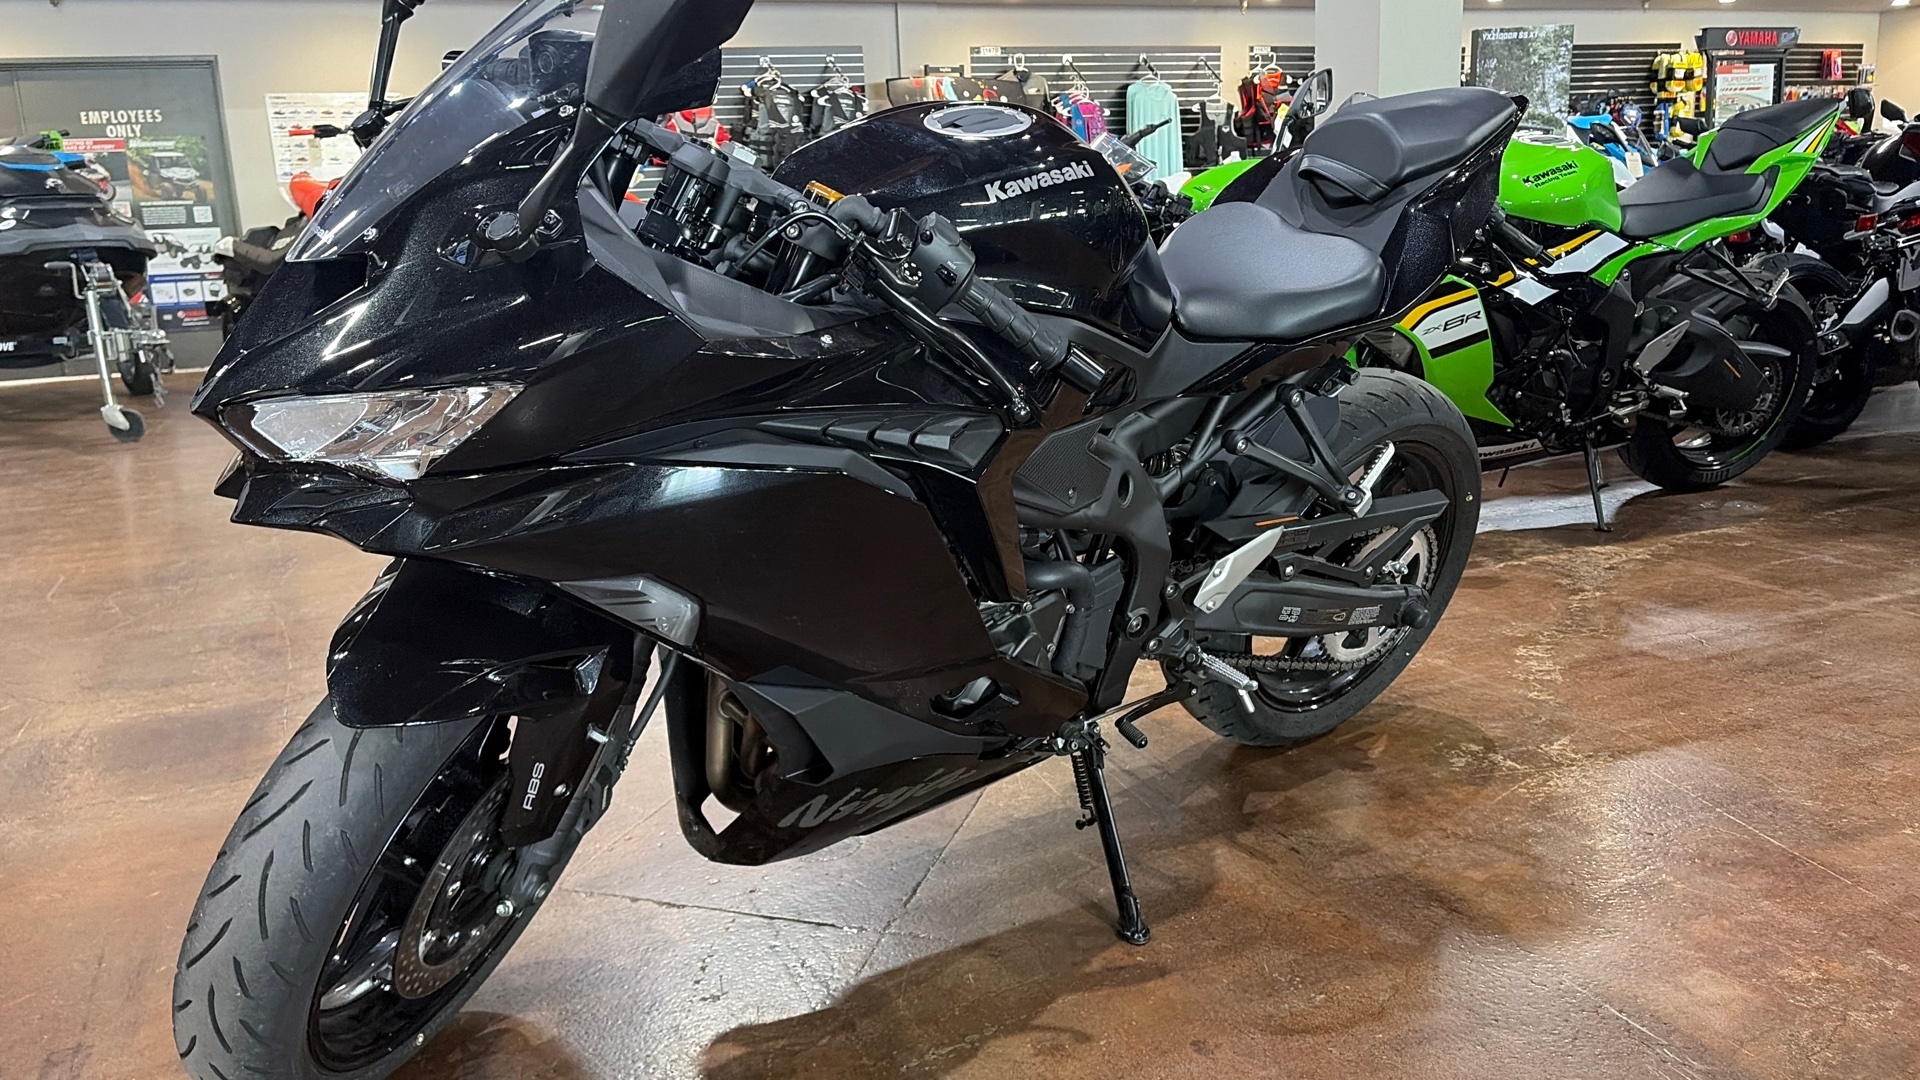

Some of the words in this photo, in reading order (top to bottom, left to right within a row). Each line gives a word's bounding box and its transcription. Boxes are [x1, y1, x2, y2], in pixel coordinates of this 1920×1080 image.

[1738, 30, 1778, 47] YAMAHA
[80, 109, 163, 125] EMPLOYEES
[106, 124, 142, 138] ONLY
[984, 160, 1095, 203] Kawasaki
[1522, 160, 1578, 185] Kawasaki
[1534, 175, 1560, 188] Racing
[1560, 170, 1577, 178] Team
[1479, 441, 1536, 457] wasaki
[522, 762, 545, 811] ABS
[777, 767, 977, 828] Ninja
